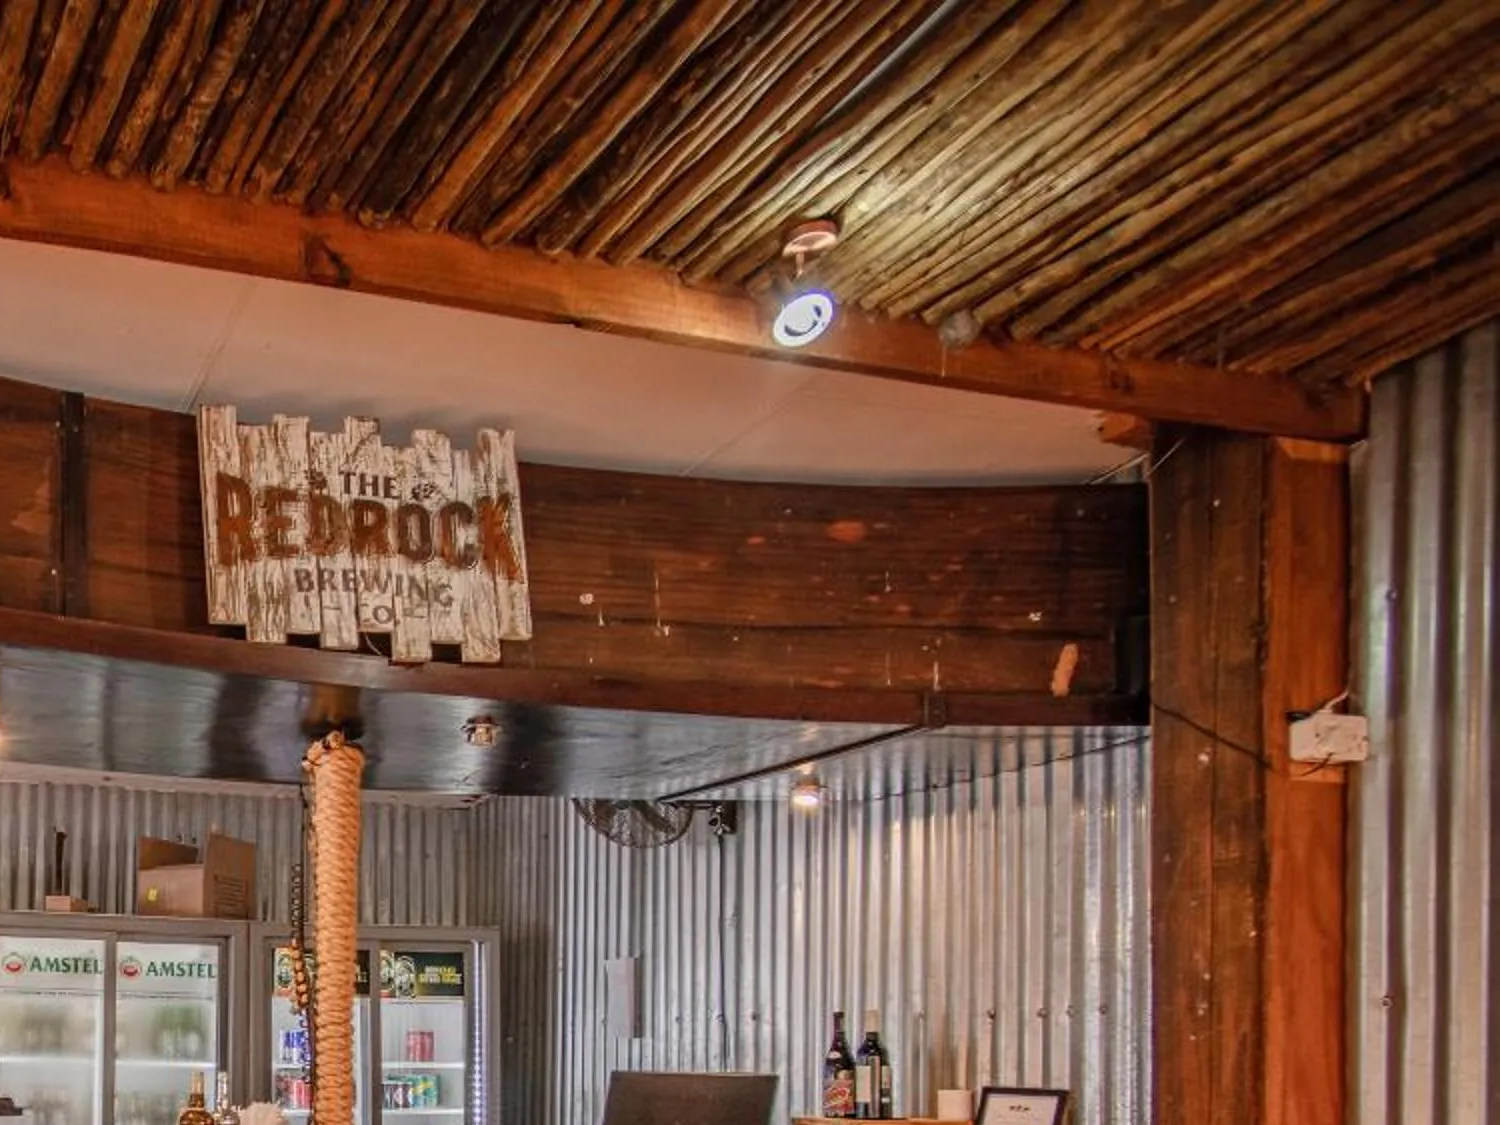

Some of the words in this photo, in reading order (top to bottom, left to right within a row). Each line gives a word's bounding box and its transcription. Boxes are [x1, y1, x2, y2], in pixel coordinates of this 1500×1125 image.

[339, 470, 398, 500] THE
[216, 471, 525, 584] REDROCK
[293, 567, 455, 608] BREWING
[29, 955, 103, 974] AMSTEL
[146, 960, 218, 979] AMSTEL
